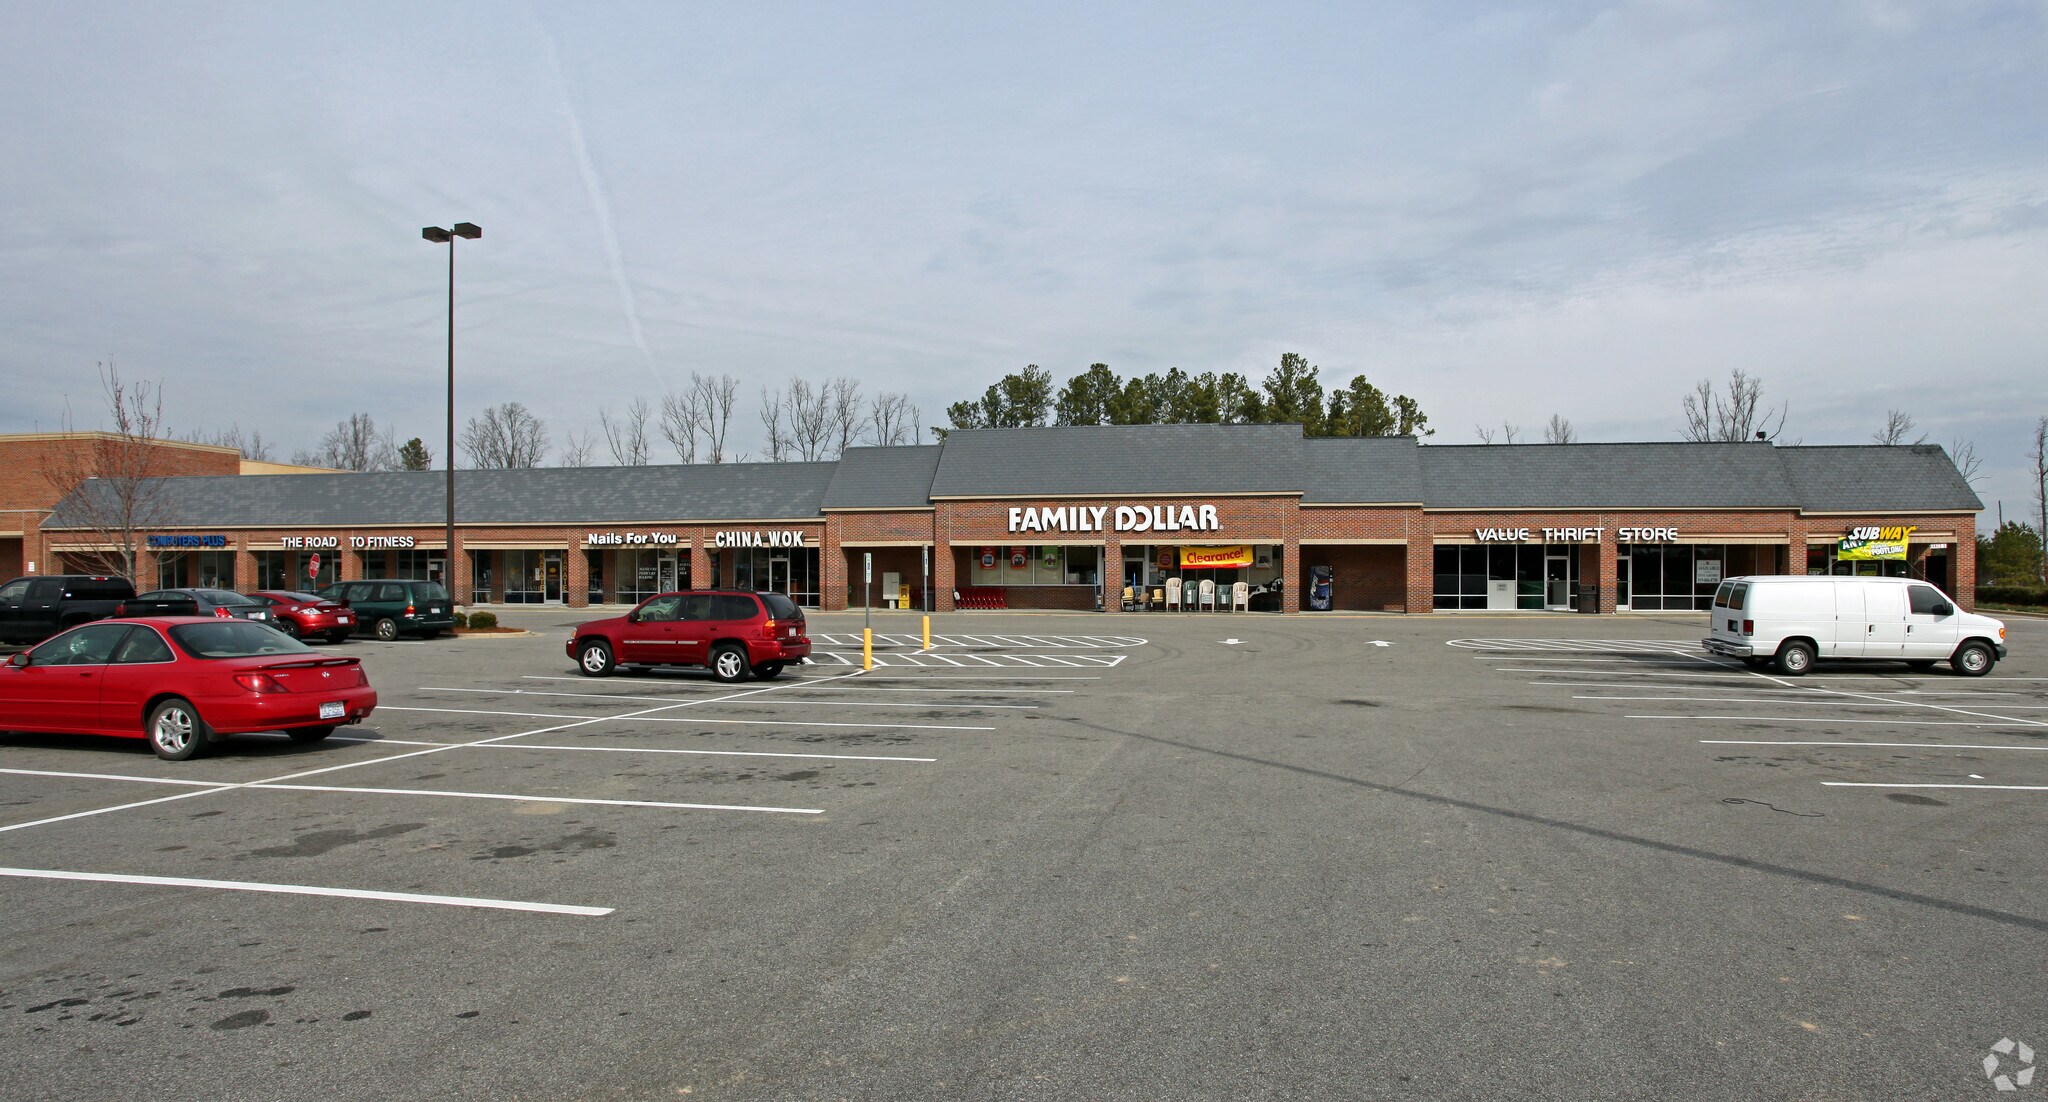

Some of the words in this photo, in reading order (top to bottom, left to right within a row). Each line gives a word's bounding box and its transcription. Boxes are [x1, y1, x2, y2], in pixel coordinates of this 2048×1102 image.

[1009, 506, 1108, 531] FAMILY
[1115, 504, 1218, 531] DOLLAR
[588, 533, 622, 546] Nails
[626, 533, 648, 546] For
[651, 532, 677, 546] You
[716, 531, 763, 547] CHINA
[769, 530, 804, 547] WOK
[1475, 528, 1529, 541] VALUE
[1541, 528, 1605, 541] THRIFT
[1618, 528, 1678, 541] STORE
[1848, 525, 1917, 540] SUBWAY
[147, 535, 200, 547] COMPUTERS
[202, 535, 226, 547] PLUS
[281, 537, 303, 548] THE
[305, 537, 338, 548] ROAD
[349, 537, 365, 548] TO
[367, 537, 415, 548] FITNESS
[1186, 547, 1244, 563] Clearance!
